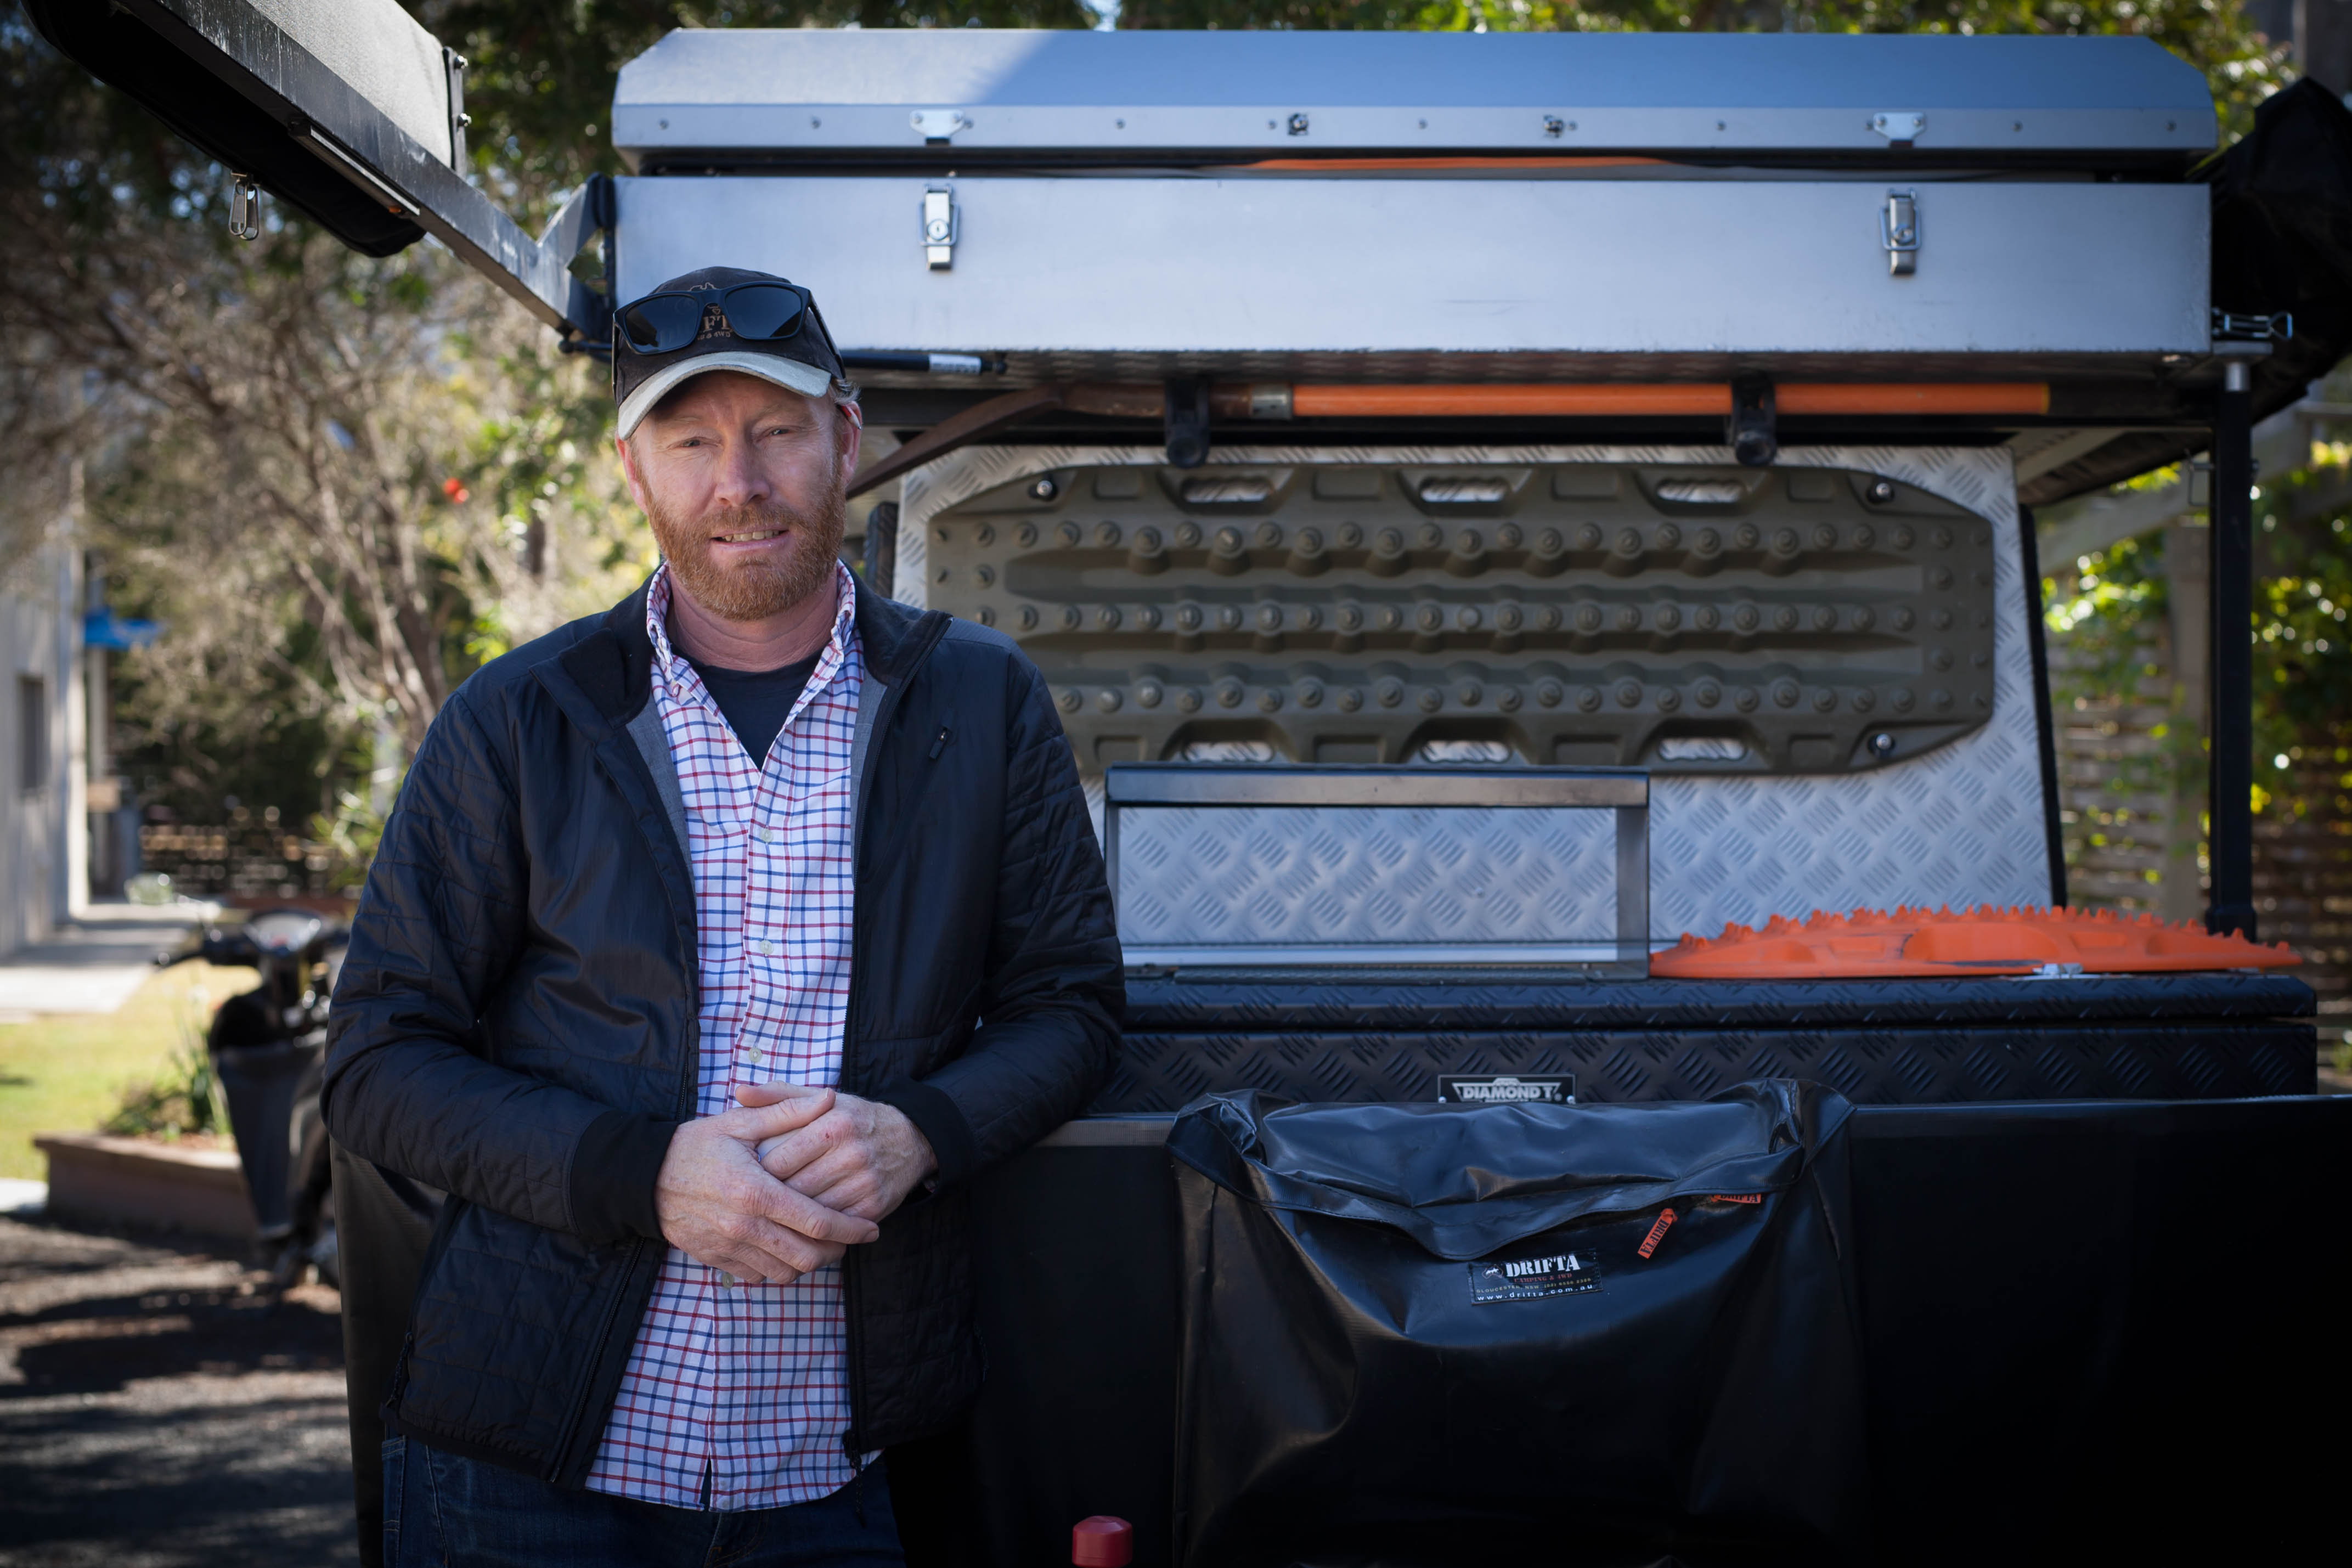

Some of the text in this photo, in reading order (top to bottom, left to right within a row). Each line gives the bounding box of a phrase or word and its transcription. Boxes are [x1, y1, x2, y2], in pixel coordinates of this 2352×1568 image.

[1463, 1087, 1541, 1098] DIAMOND
[1640, 1219, 1669, 1255] DRIFTA
[1505, 1254, 1581, 1277] DRIFTA
[1477, 1284, 1593, 1301] www.drifta.com.au
